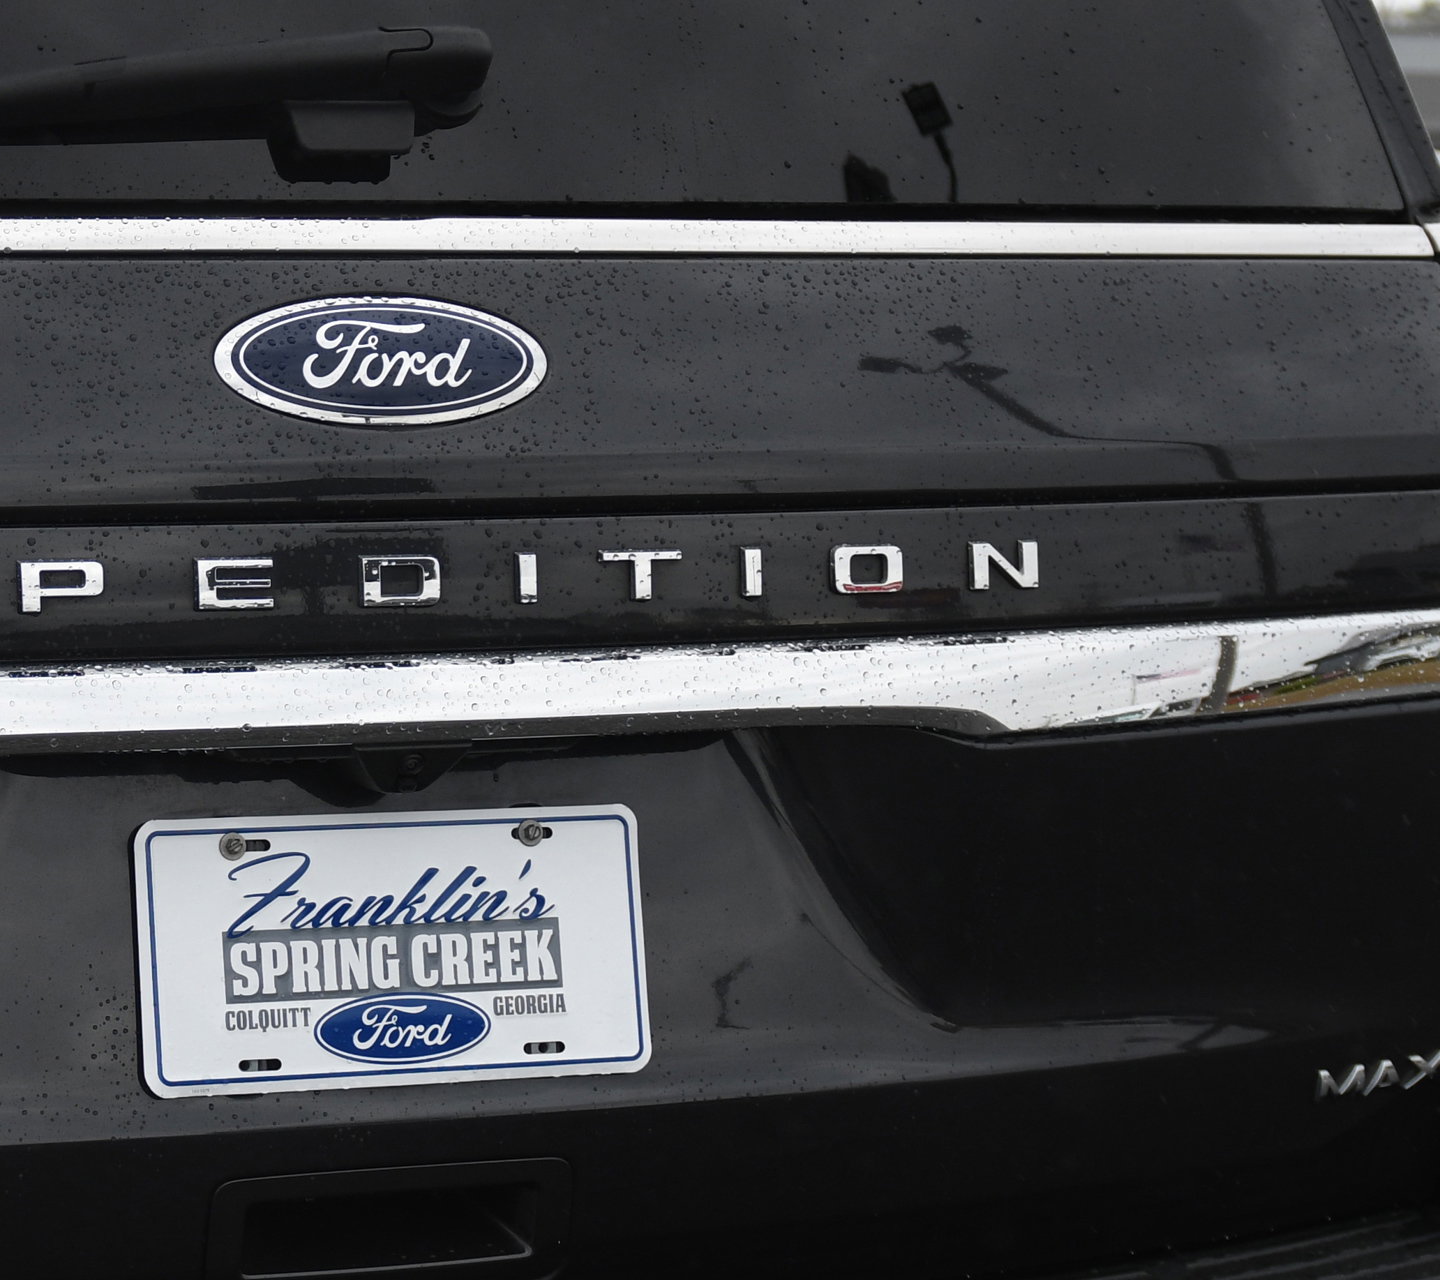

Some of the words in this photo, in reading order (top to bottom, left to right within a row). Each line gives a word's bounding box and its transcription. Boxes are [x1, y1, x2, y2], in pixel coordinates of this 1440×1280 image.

[302, 320, 473, 389] Ford
[225, 850, 558, 940] Franklin's
[231, 935, 401, 998] SPRING
[411, 928, 561, 988] CREEK
[225, 1006, 313, 1034] COLQUITT
[353, 1004, 454, 1052] Ford
[492, 993, 568, 1018] GEORGIA
